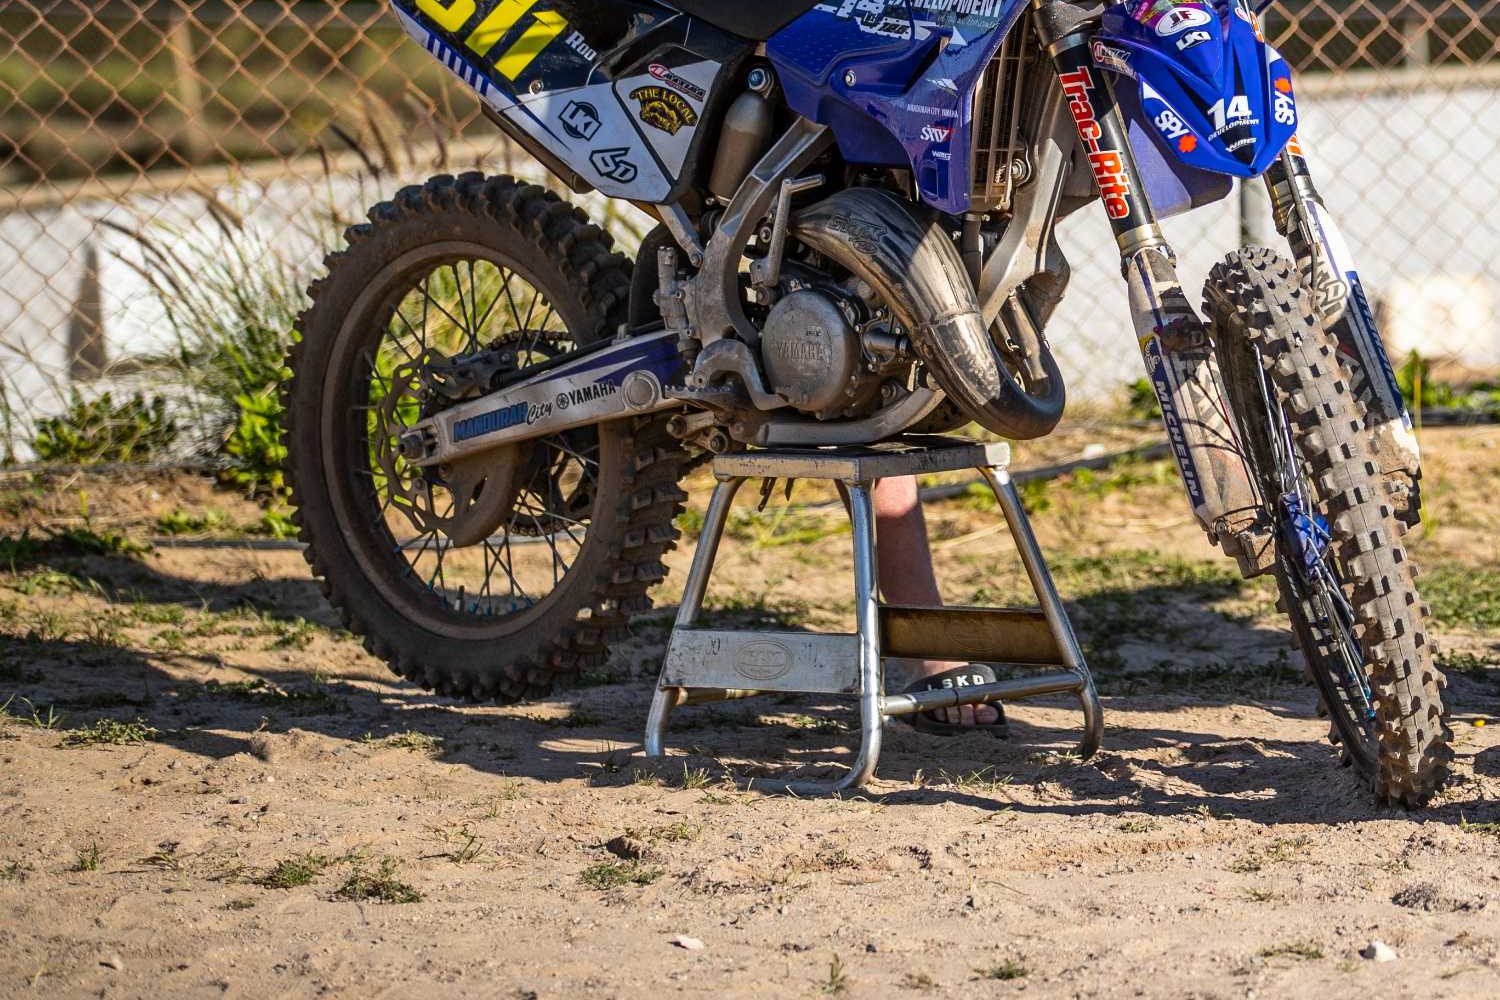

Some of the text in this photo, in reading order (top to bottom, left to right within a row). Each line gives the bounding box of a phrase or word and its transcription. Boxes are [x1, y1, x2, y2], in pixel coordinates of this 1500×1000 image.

[1170, 9, 1193, 26] JF
[637, 87, 659, 102] THE
[662, 89, 696, 124] LOCAL
[1207, 95, 1253, 131] 14
[1274, 90, 1295, 126] SPY
[1058, 65, 1131, 220] Trac-Rite
[1153, 110, 1189, 139] SPY
[1208, 116, 1260, 142] DEVELOPMENT
[776, 341, 826, 361] YAMAHA
[453, 380, 617, 443] MANDURAH City YAMAHA
[1156, 379, 1200, 498] MICHELIN
